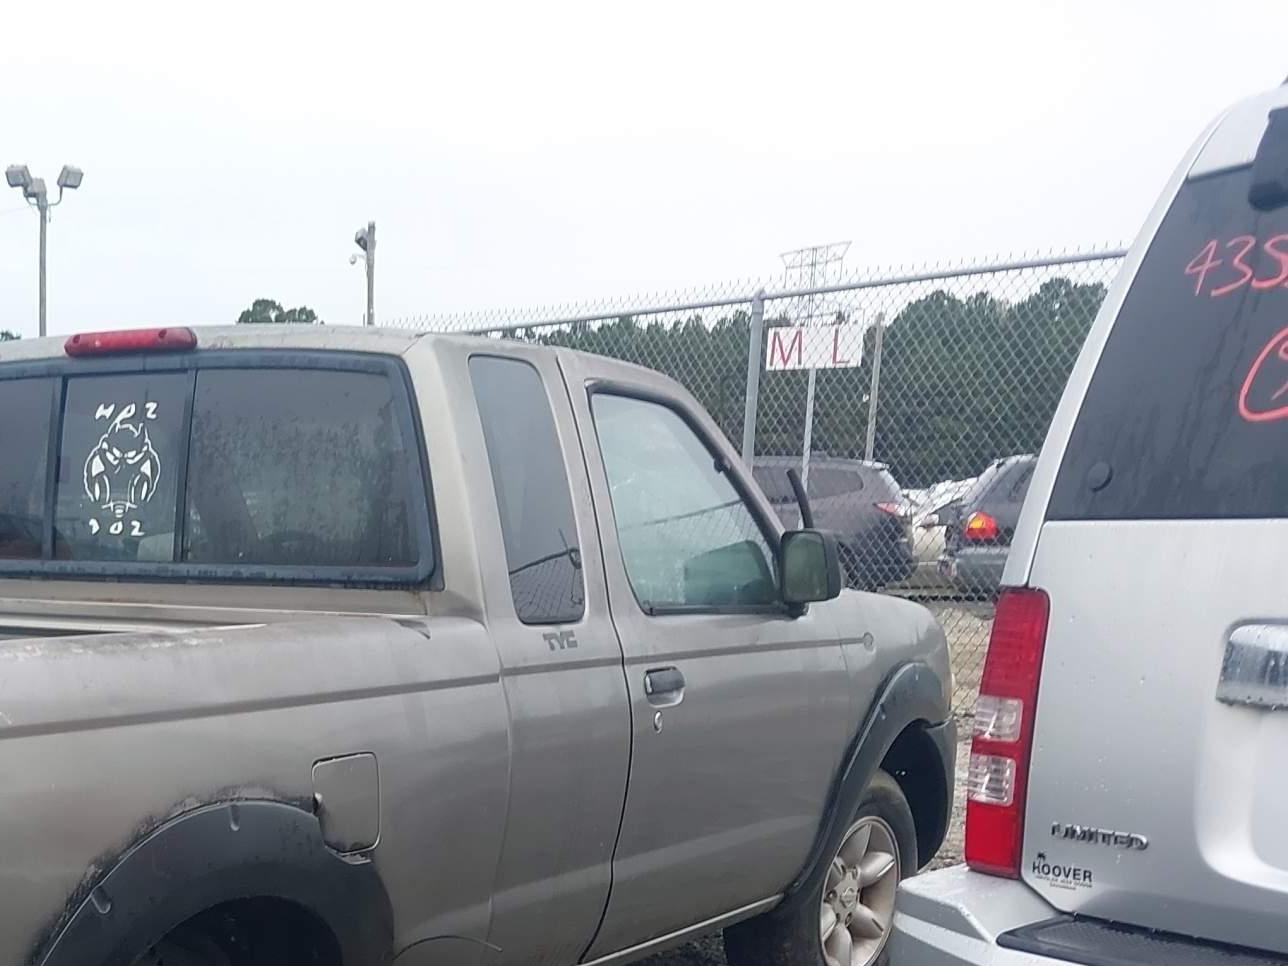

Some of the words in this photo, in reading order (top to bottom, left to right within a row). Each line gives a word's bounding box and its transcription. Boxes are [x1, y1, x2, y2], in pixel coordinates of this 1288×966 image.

[1184, 234, 1288, 297] 435
[769, 328, 803, 368] M
[832, 327, 851, 365] L
[1032, 861, 1093, 883] HOOVER
